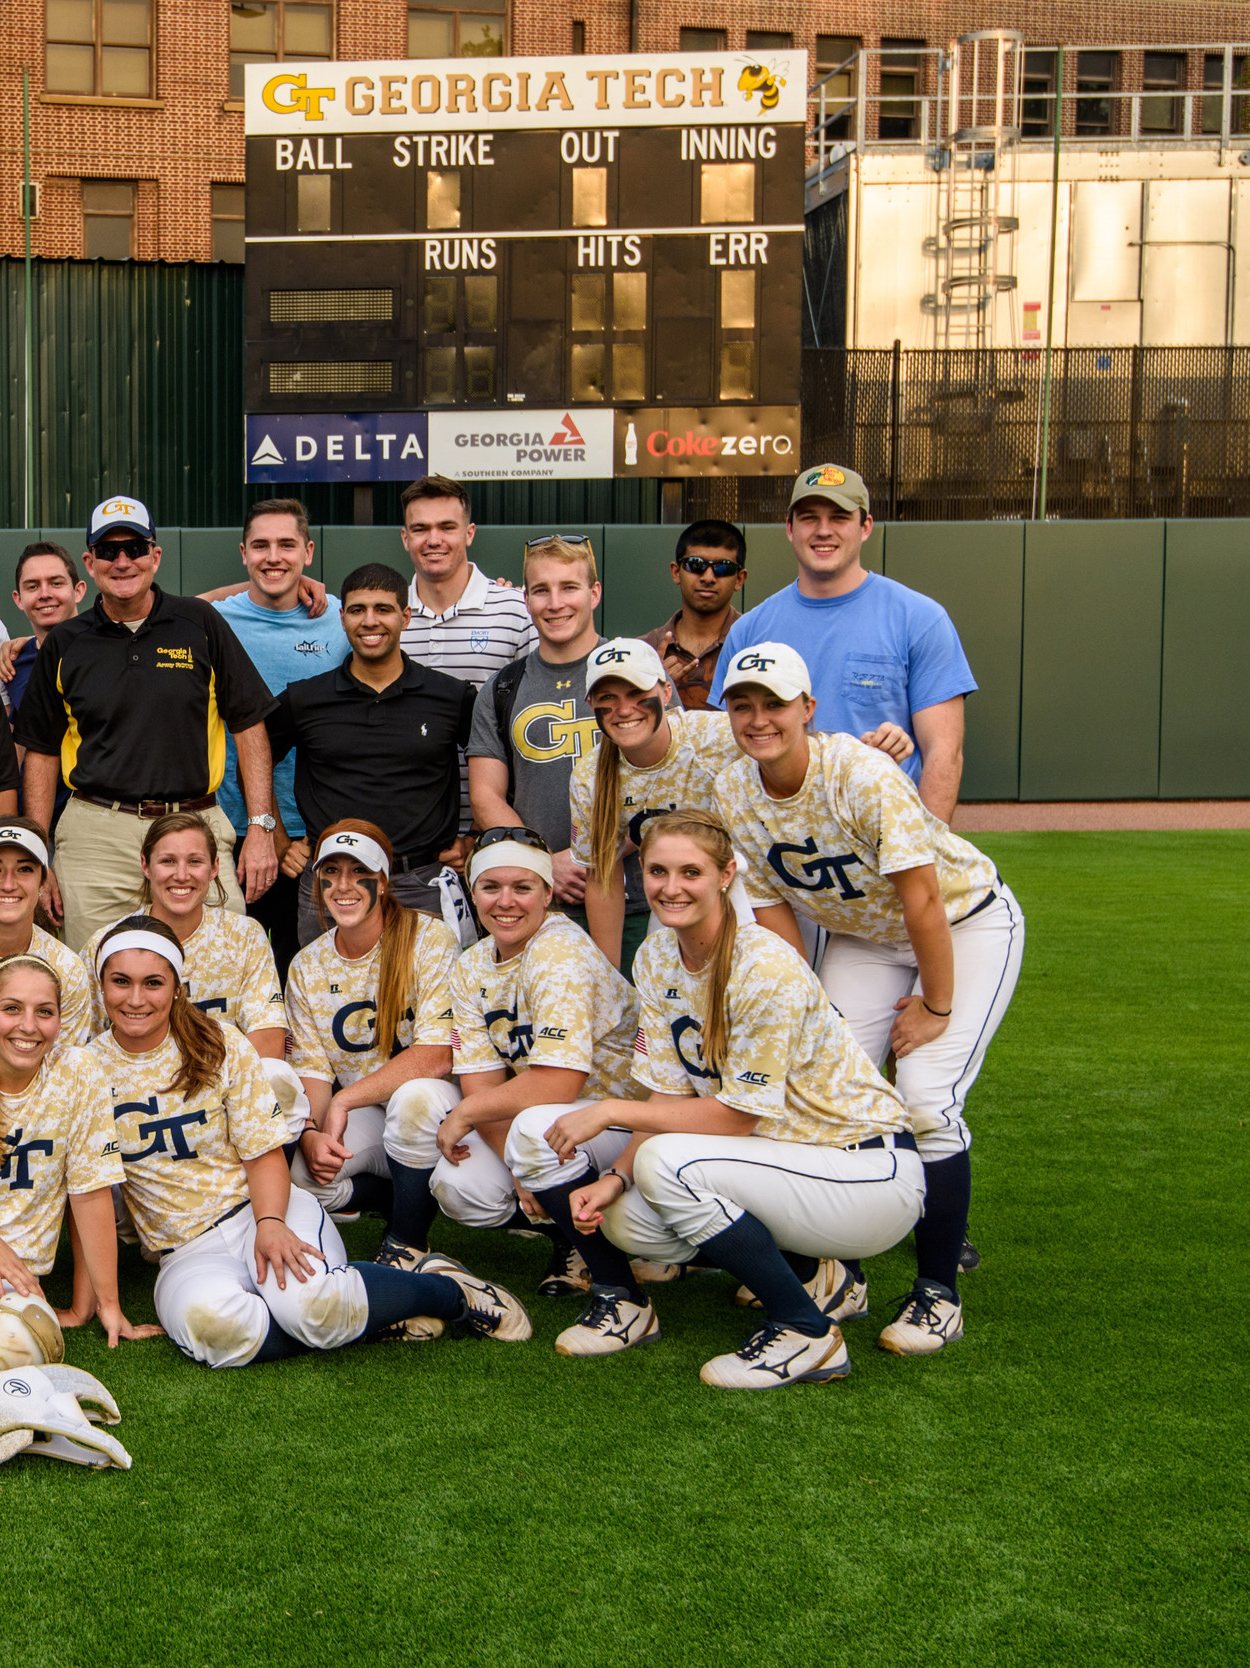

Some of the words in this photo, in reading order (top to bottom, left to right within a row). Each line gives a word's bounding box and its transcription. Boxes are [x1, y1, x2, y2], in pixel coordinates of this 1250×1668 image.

[262, 74, 335, 120] GT
[345, 71, 573, 115] GEORGIA
[586, 67, 725, 109] TECH
[275, 137, 352, 170] BALL
[393, 134, 494, 167] STRIKE
[560, 131, 620, 164] OUT
[681, 127, 777, 160] INNING
[424, 238, 497, 270] RUNS
[577, 235, 642, 267] HITS
[709, 233, 768, 265] ERR
[295, 433, 424, 462] DELTA
[454, 433, 544, 447] GEORGIA
[516, 448, 586, 462] POWER
[646, 430, 718, 457] Coke
[720, 434, 792, 456] zero
[102, 500, 136, 516] GT
[156, 647, 187, 655] Georgia
[595, 648, 631, 665] GT
[737, 653, 775, 672] GT
[511, 699, 602, 770] GT
[0, 829, 22, 840] GT
[336, 835, 358, 847] GT
[767, 836, 866, 901] GT
[539, 1027, 569, 1038] ACC
[739, 1071, 771, 1084] ACC
[114, 1096, 208, 1162] GT
